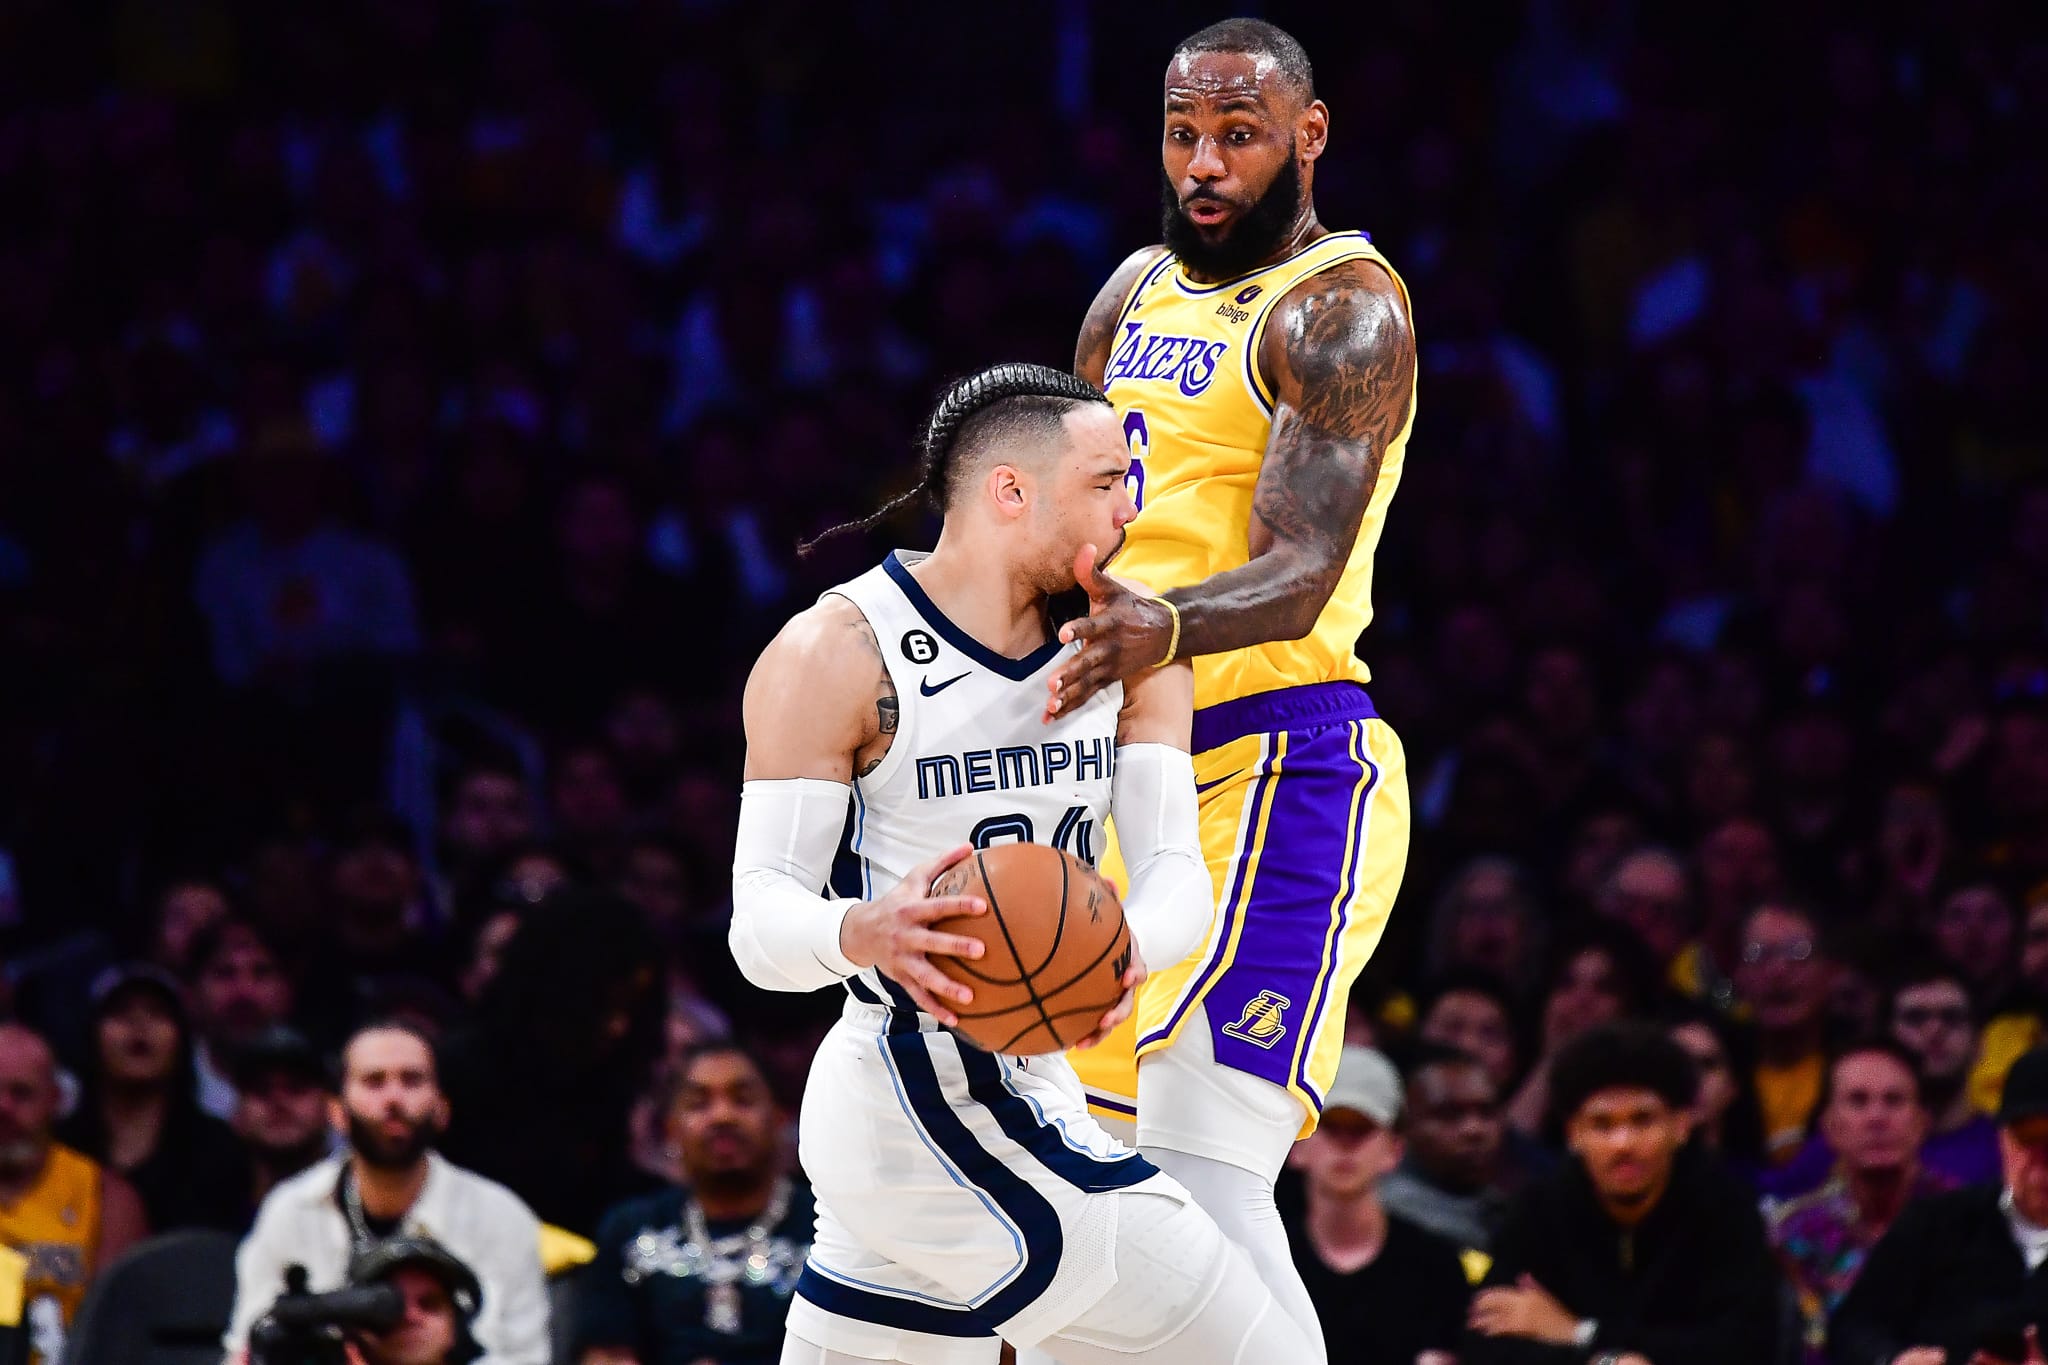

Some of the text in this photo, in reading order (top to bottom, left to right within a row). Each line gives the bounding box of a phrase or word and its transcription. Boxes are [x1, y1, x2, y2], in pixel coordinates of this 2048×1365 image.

[1216, 302, 1249, 324] bibigo
[908, 634, 932, 660] 6
[916, 736, 1117, 799] MEMPHI
